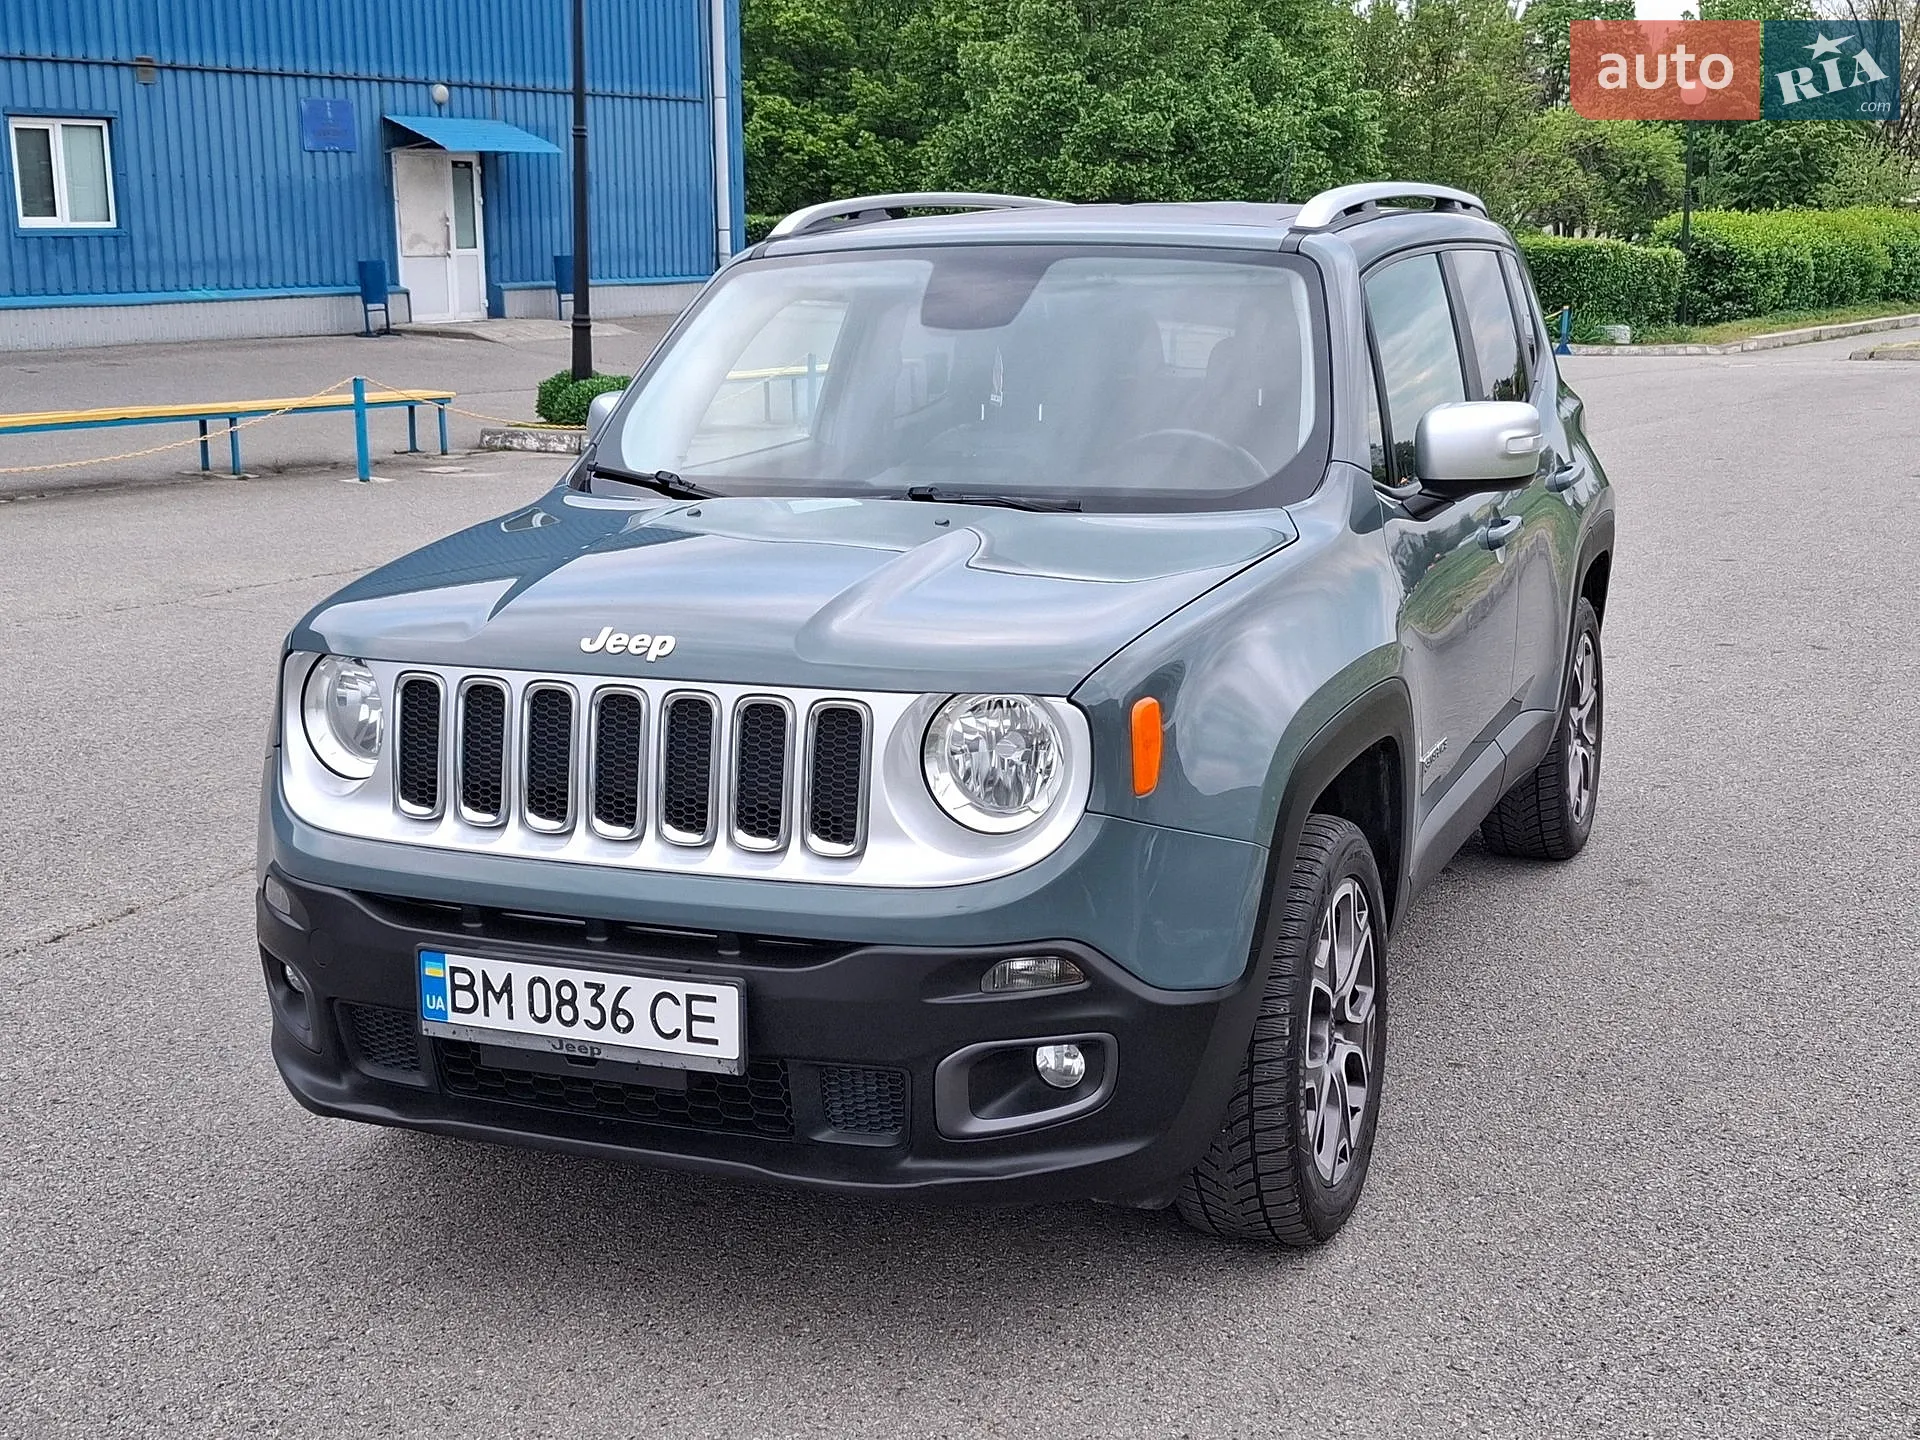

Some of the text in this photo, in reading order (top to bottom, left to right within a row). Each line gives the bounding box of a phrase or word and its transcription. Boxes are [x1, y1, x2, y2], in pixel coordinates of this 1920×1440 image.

[580, 626, 676, 663] Jeep
[426, 994, 446, 1012] UA
[449, 965, 719, 1046] BM 0836 CE
[551, 1039, 602, 1056] Jeep
